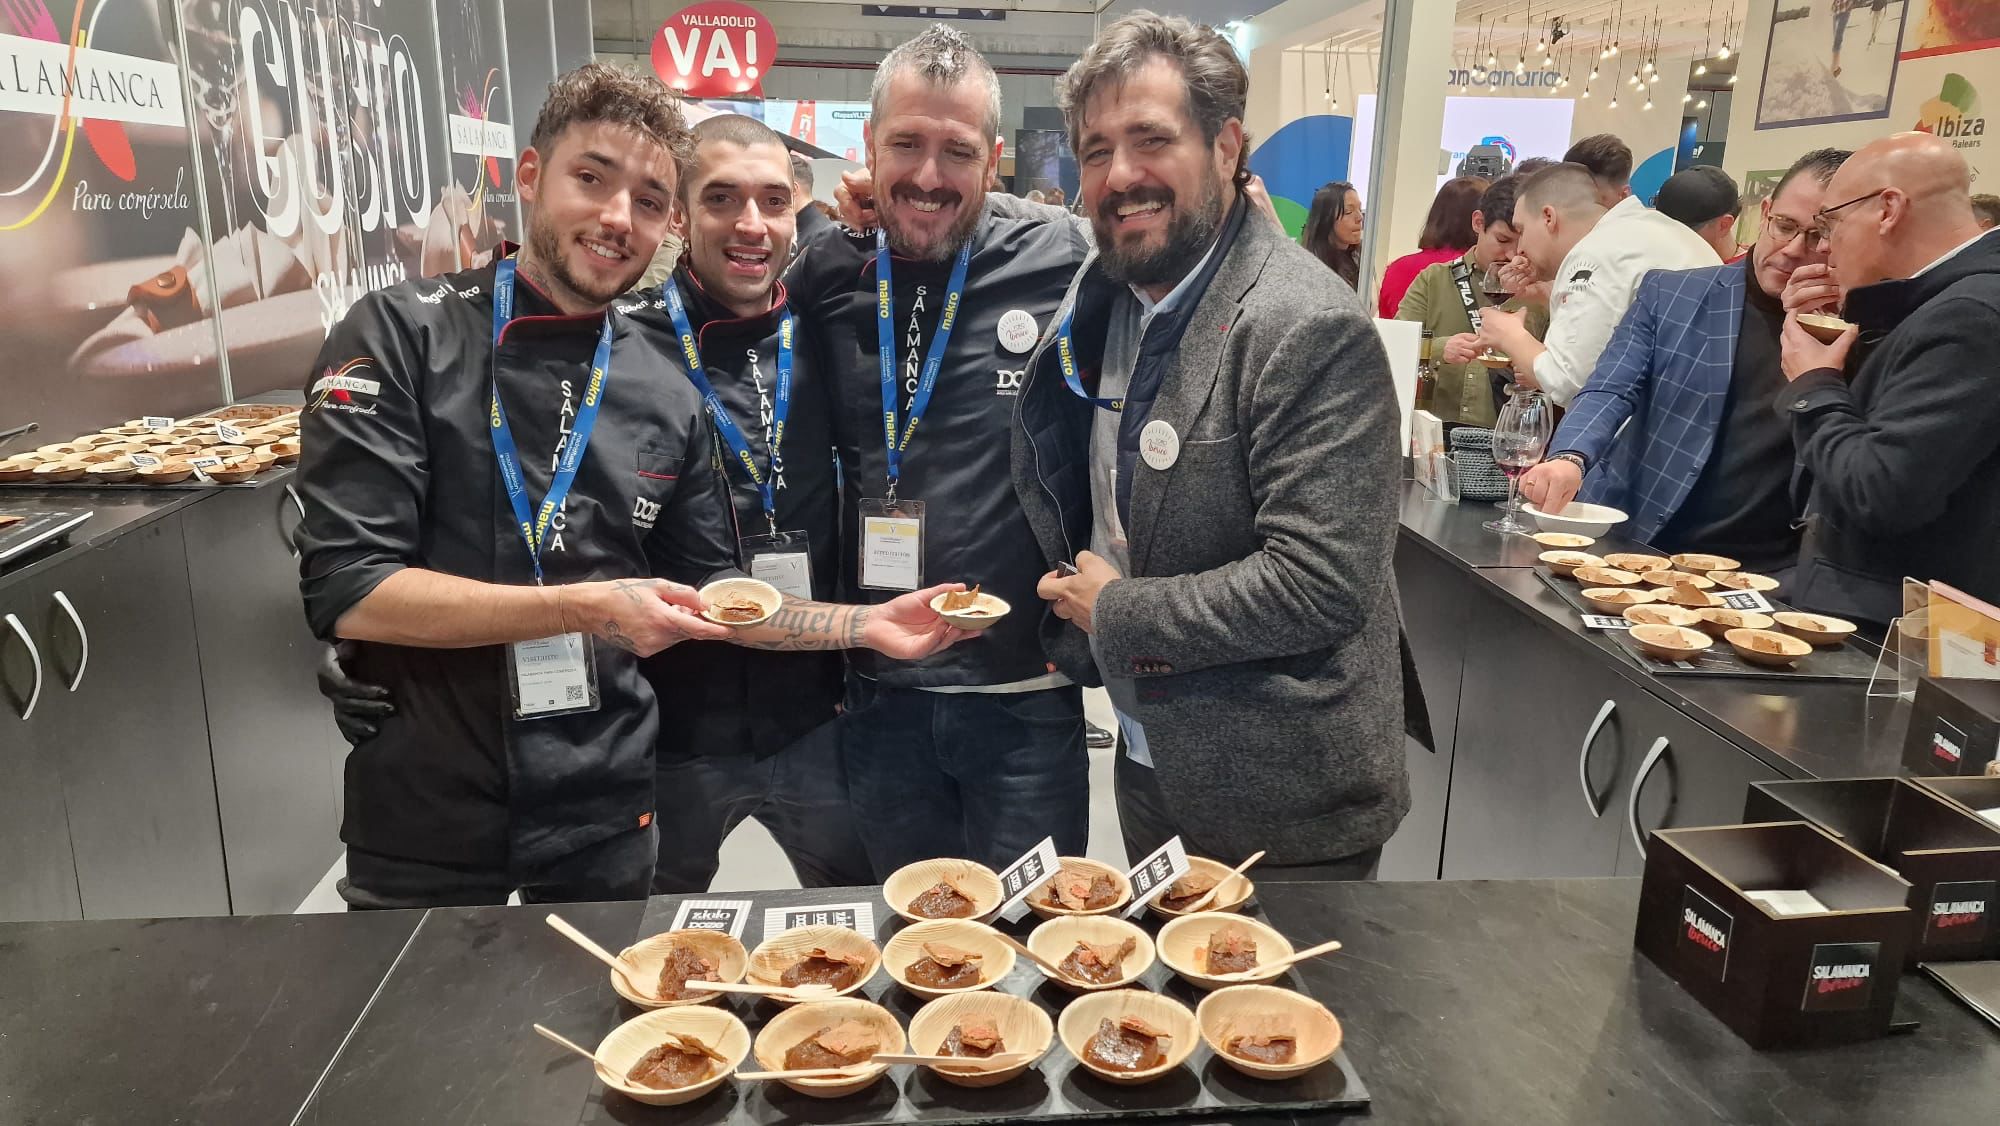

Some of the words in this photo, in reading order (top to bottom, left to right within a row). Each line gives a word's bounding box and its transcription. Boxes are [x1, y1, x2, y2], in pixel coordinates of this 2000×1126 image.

[681, 14, 756, 28] VALLADOLID
[663, 26, 759, 79] VA!
[0, 54, 163, 109] LAMANCA
[228, 0, 432, 237] GUSTO
[458, 124, 507, 150] SALAMANCA
[1937, 114, 1985, 138] Ibiza
[1952, 139, 1981, 149] Balears
[72, 180, 114, 212] Para
[118, 166, 190, 220] comérsela
[879, 279, 890, 319] makro
[941, 291, 959, 331] makro
[1458, 280, 1475, 306] FILA
[682, 334, 700, 370] makro
[781, 319, 793, 350] makro
[1059, 336, 1074, 376] makro
[321, 378, 368, 391] MANCA
[585, 366, 604, 407] makro
[492, 395, 502, 428] kro
[746, 348, 788, 490] SALAMACA
[885, 411, 897, 450] makro
[898, 416, 919, 452] makro
[551, 380, 575, 552] SALACA
[739, 449, 763, 485] makro
[535, 500, 556, 545] makro
[769, 606, 842, 641] ngel
[1684, 908, 1726, 949] SALAMANCA
